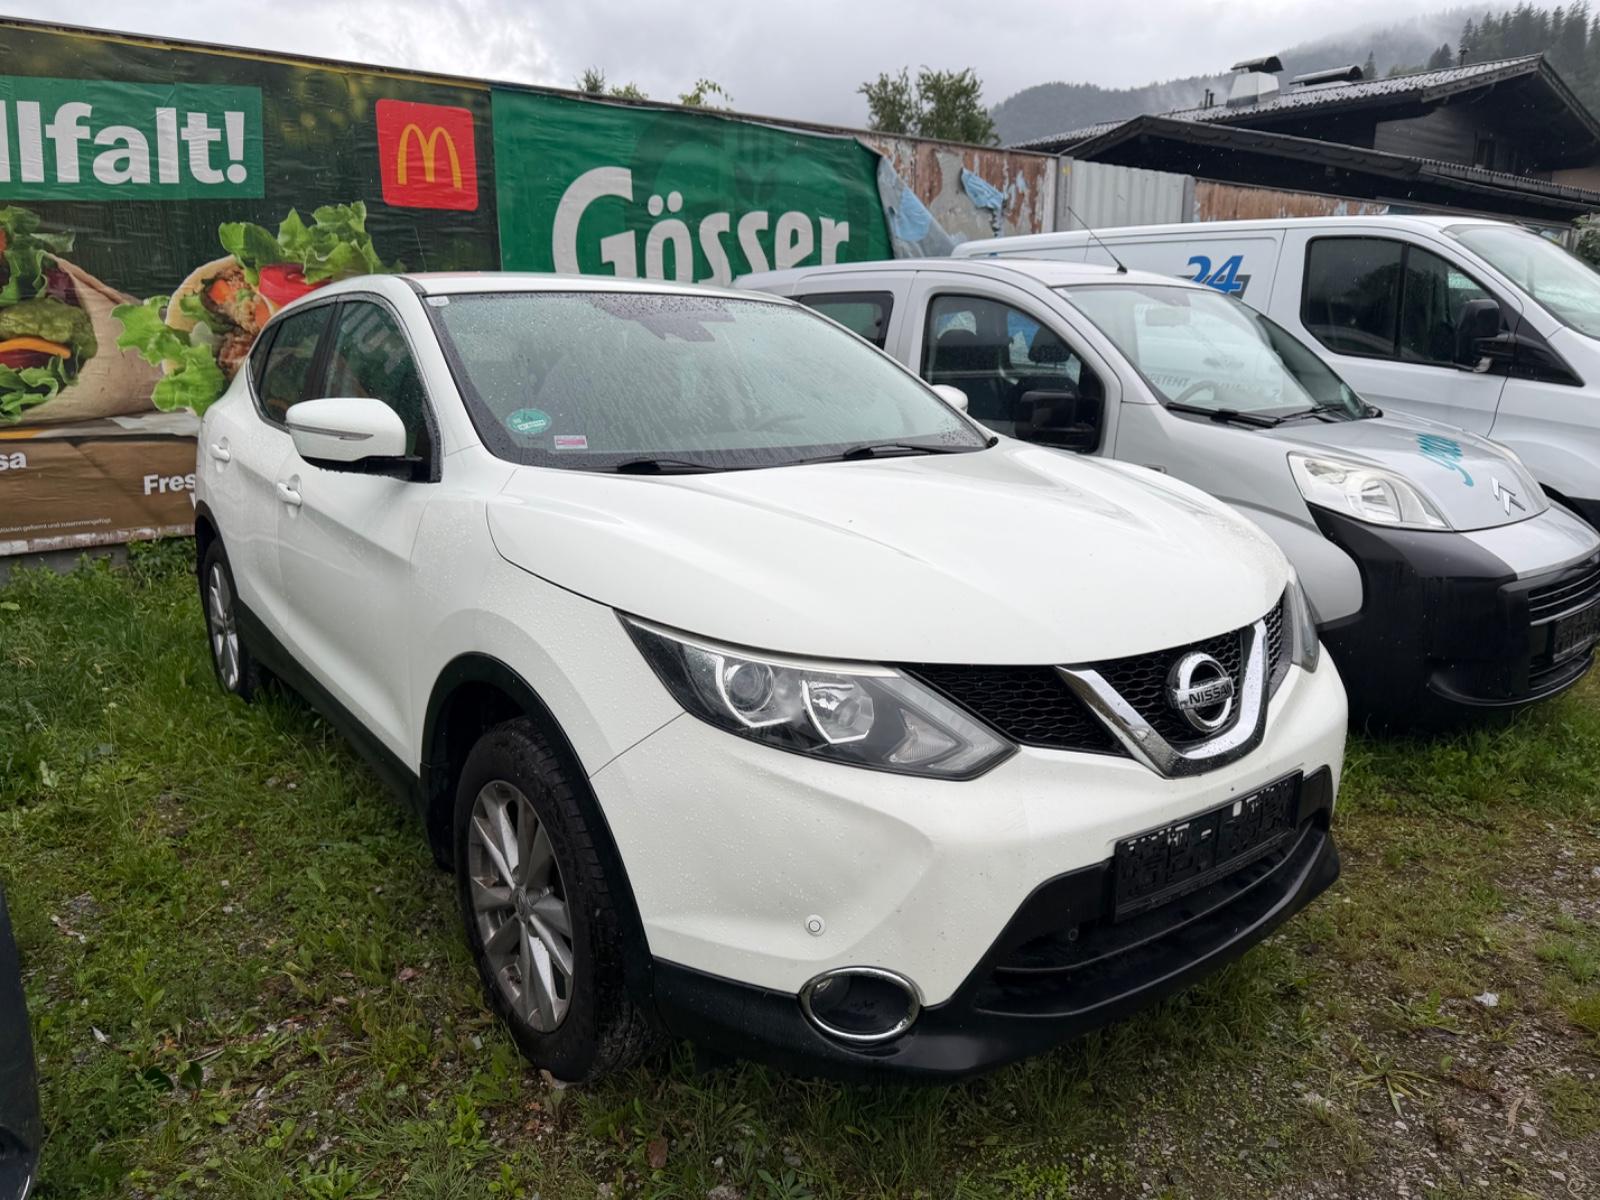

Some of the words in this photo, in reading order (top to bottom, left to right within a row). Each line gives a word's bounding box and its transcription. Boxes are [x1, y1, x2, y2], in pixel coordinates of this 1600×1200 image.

[552, 166, 850, 287] Gösser
[1187, 254, 1244, 294] 24
[1189, 684, 1231, 704] NISSAN
